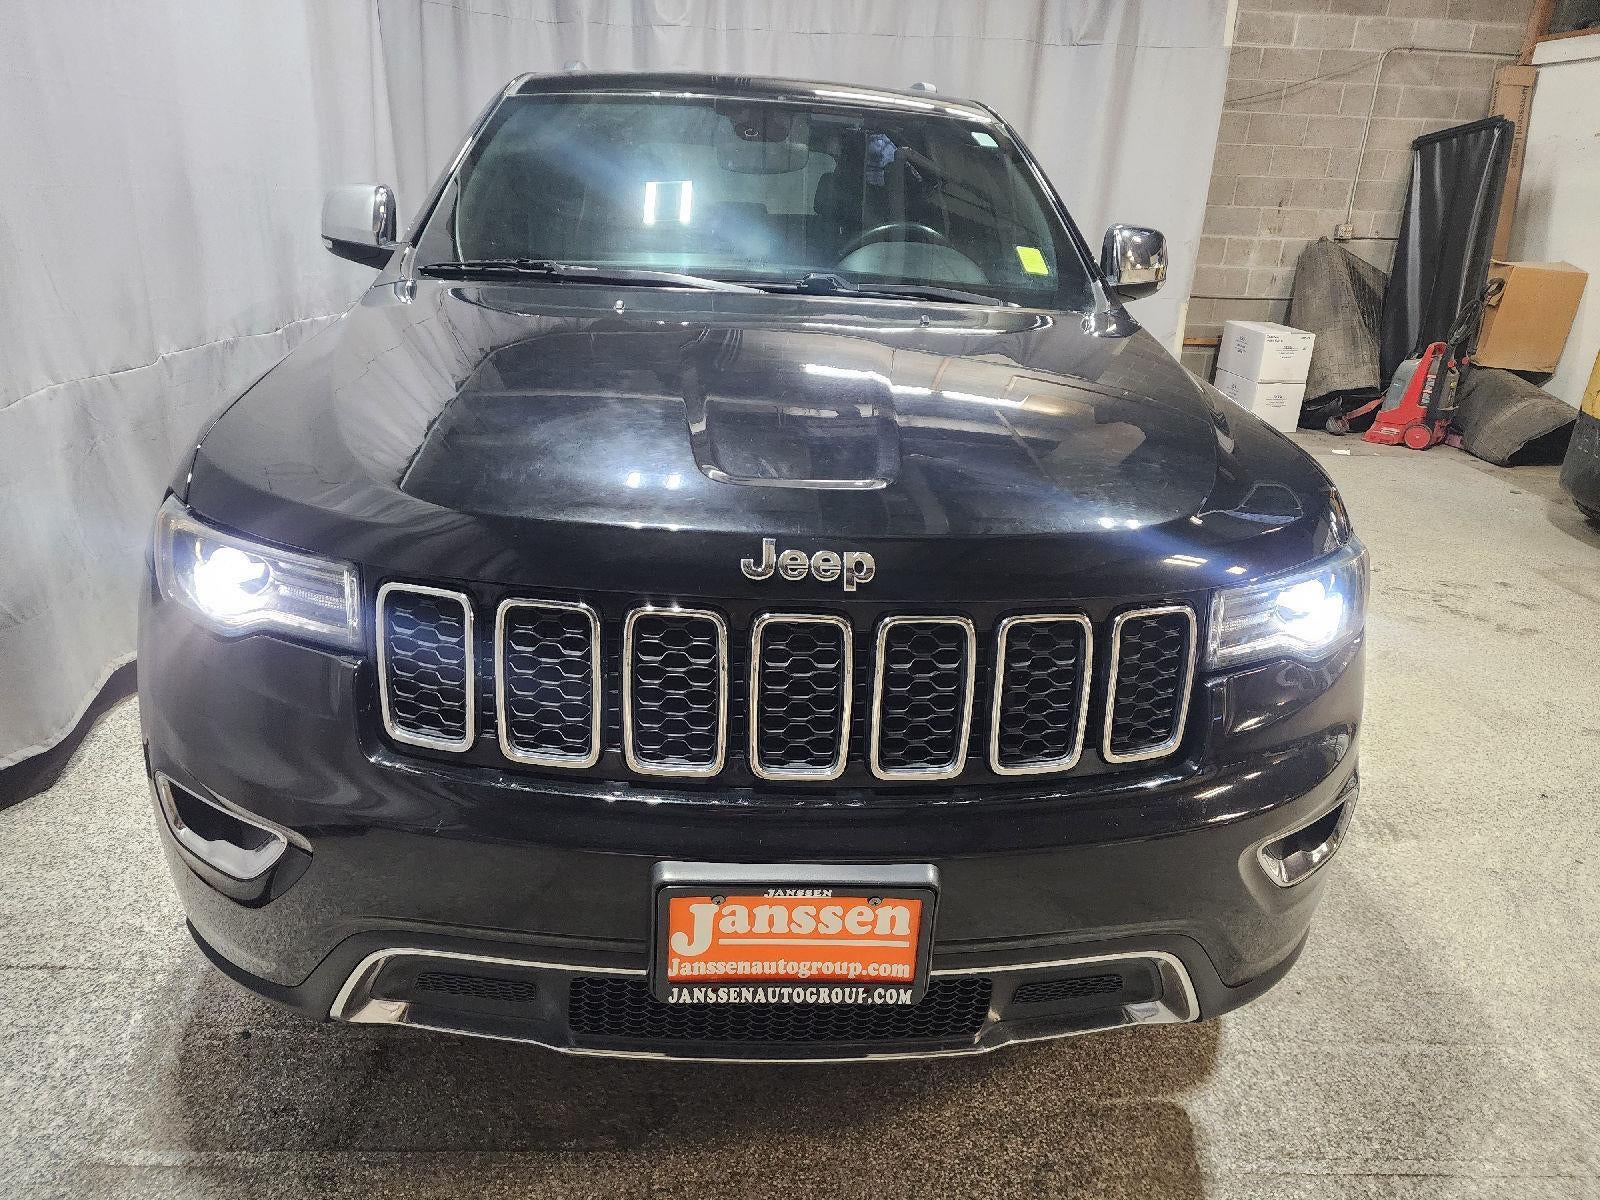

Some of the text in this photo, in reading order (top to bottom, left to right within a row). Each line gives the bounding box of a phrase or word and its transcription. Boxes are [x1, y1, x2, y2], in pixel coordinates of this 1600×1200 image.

[740, 537, 876, 592] Jeep
[763, 889, 833, 899] JANSSEN
[670, 903, 911, 957] Janssen
[668, 958, 910, 979] Janssenautogroup.com
